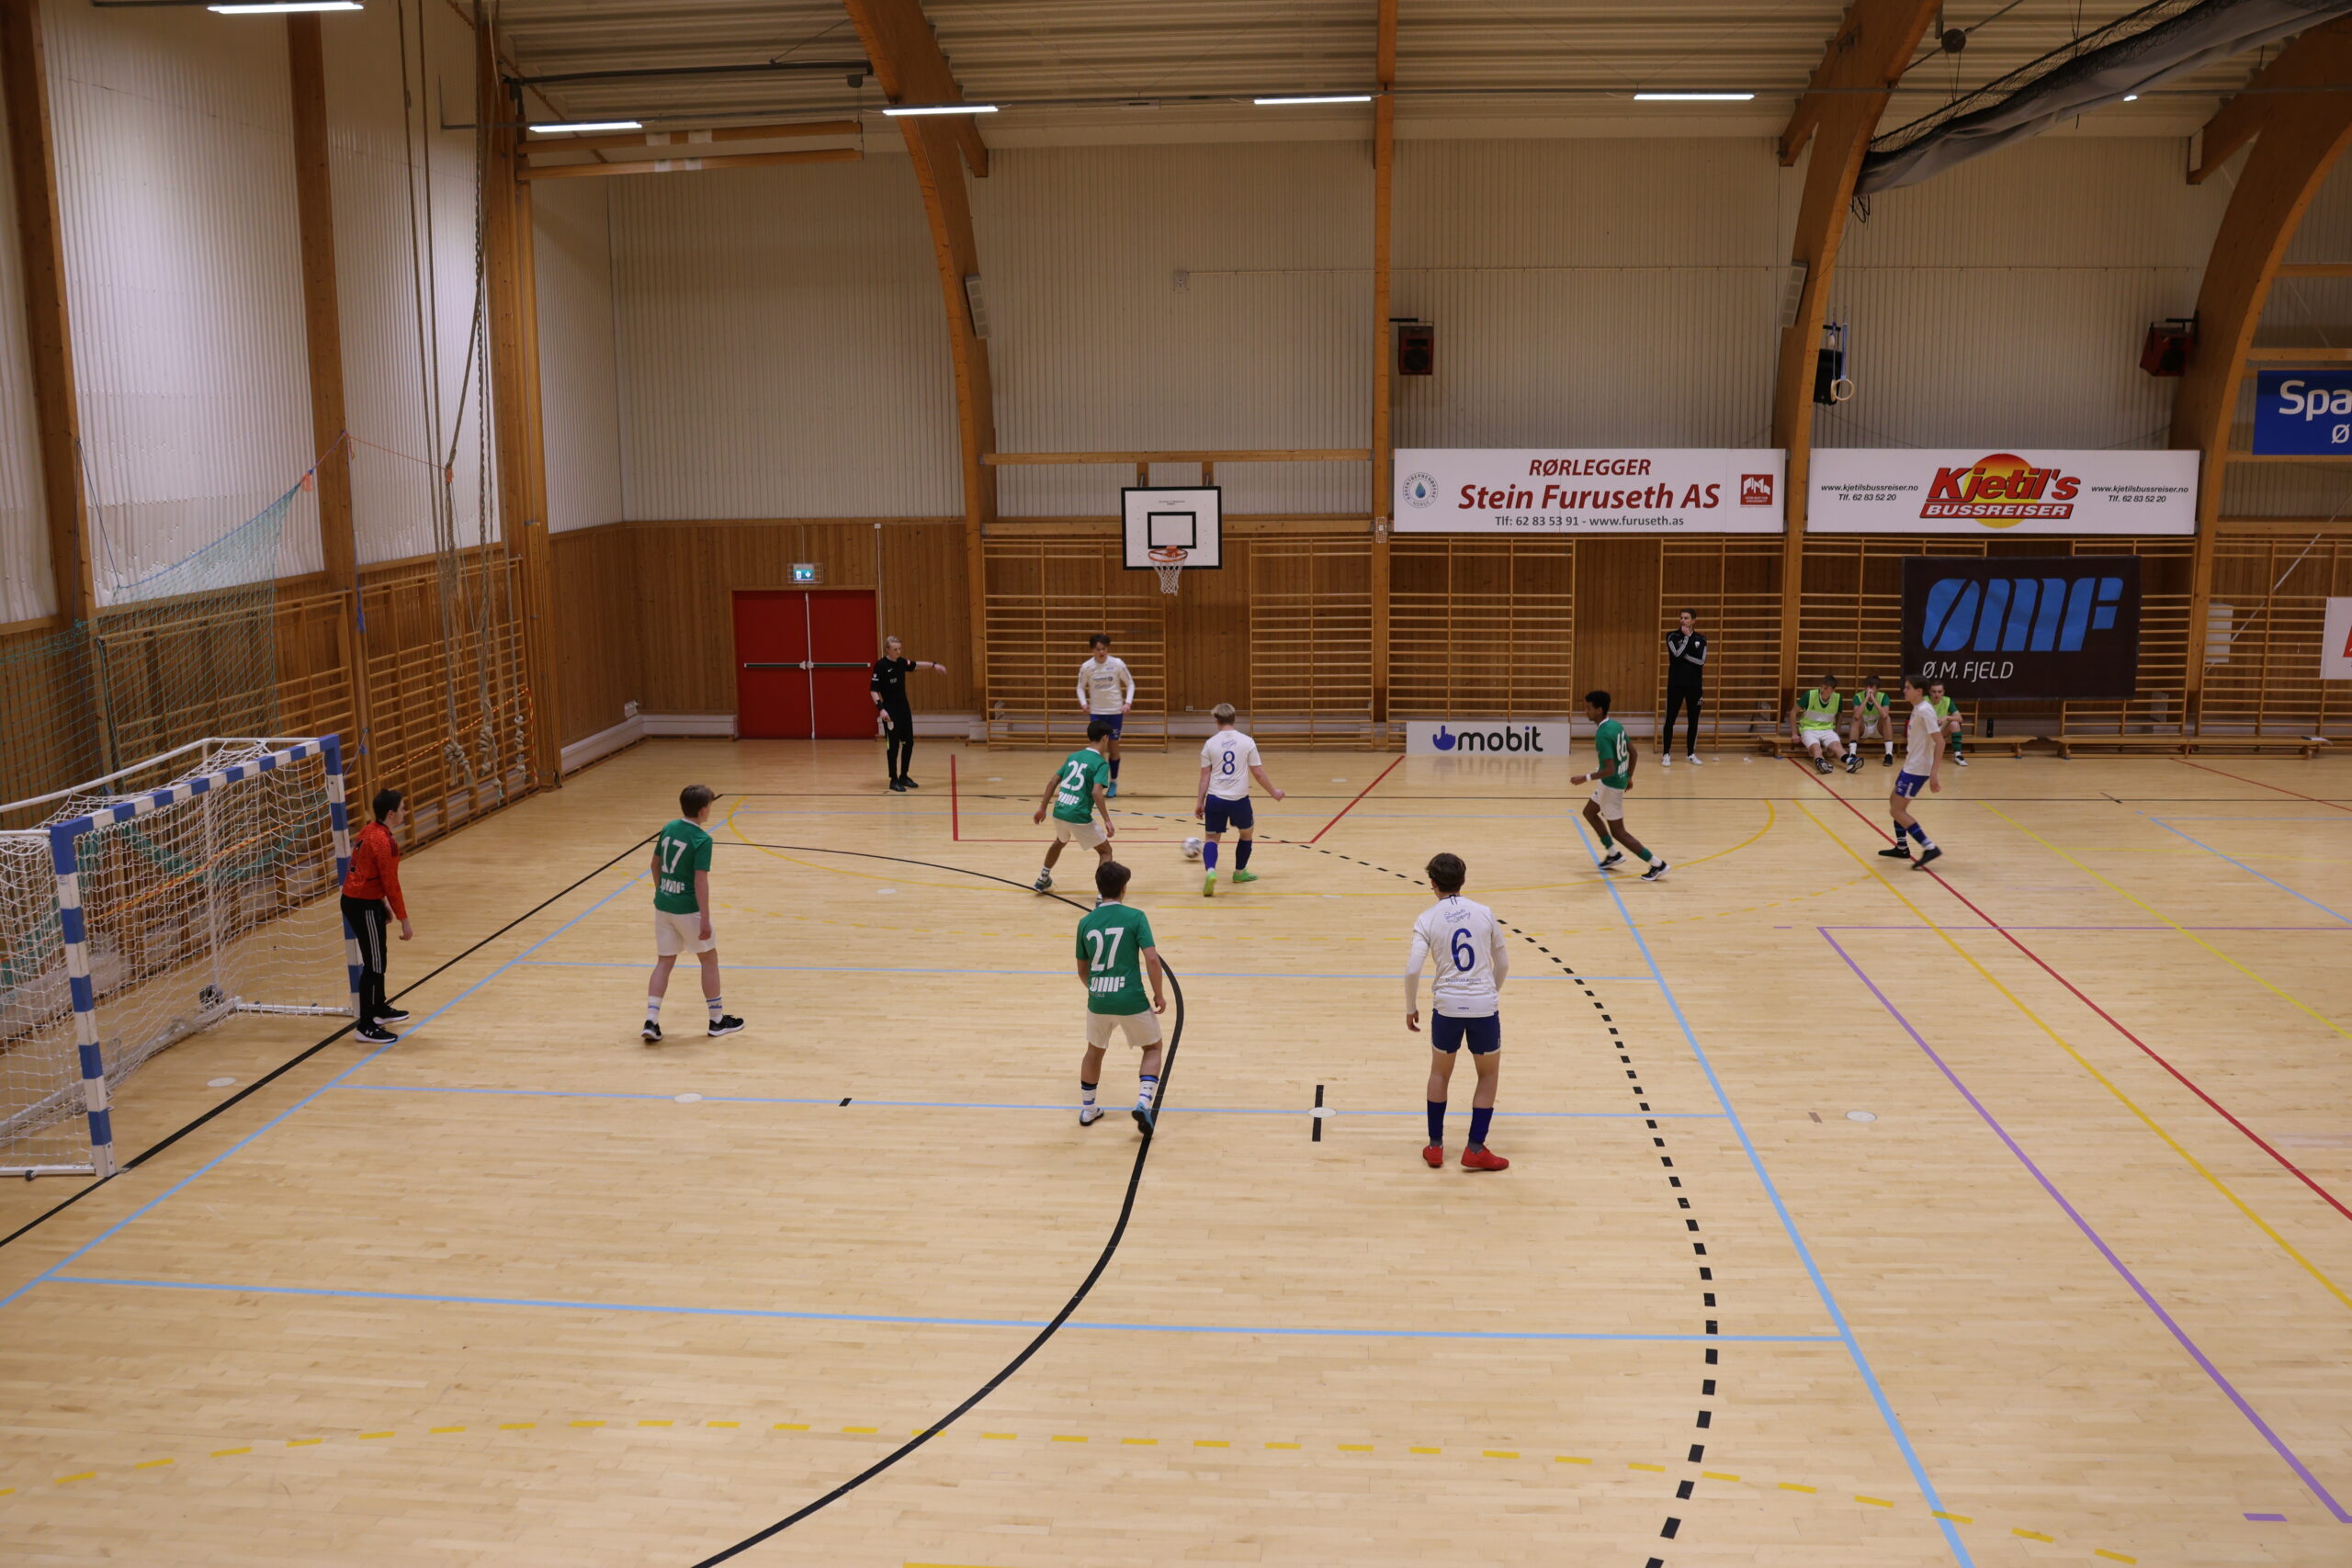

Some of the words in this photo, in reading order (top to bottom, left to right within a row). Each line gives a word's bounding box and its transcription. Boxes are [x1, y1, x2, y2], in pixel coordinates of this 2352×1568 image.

[1529, 458, 1651, 477] RØRLEGGER
[1458, 483, 1534, 509] Stein
[1541, 482, 1674, 509] Furuseth
[1679, 483, 1721, 509] AS
[1821, 484, 1918, 492] www.kjetilsbussreiser.no
[1926, 467, 2081, 502] Kjetil's
[2091, 485, 2188, 493] www.kjetilsbussreiser.no
[1495, 516, 1513, 526] Tlf:
[1516, 516, 1529, 526] 62
[1532, 516, 1545, 526] 83
[1549, 516, 1562, 526] 53
[1566, 516, 1578, 526] 91
[1589, 515, 1684, 526] www.furuseth.as
[1926, 504, 2067, 516] BUSSREISER
[1922, 660, 1959, 679] Ø.M.
[1962, 661, 2014, 682] FJELD
[1457, 725, 1544, 751] mobit
[1222, 750, 1236, 775] 8
[1060, 761, 1088, 791] 25
[662, 836, 687, 874] 17
[1086, 927, 1125, 971] 27
[1451, 928, 1476, 972] 6
